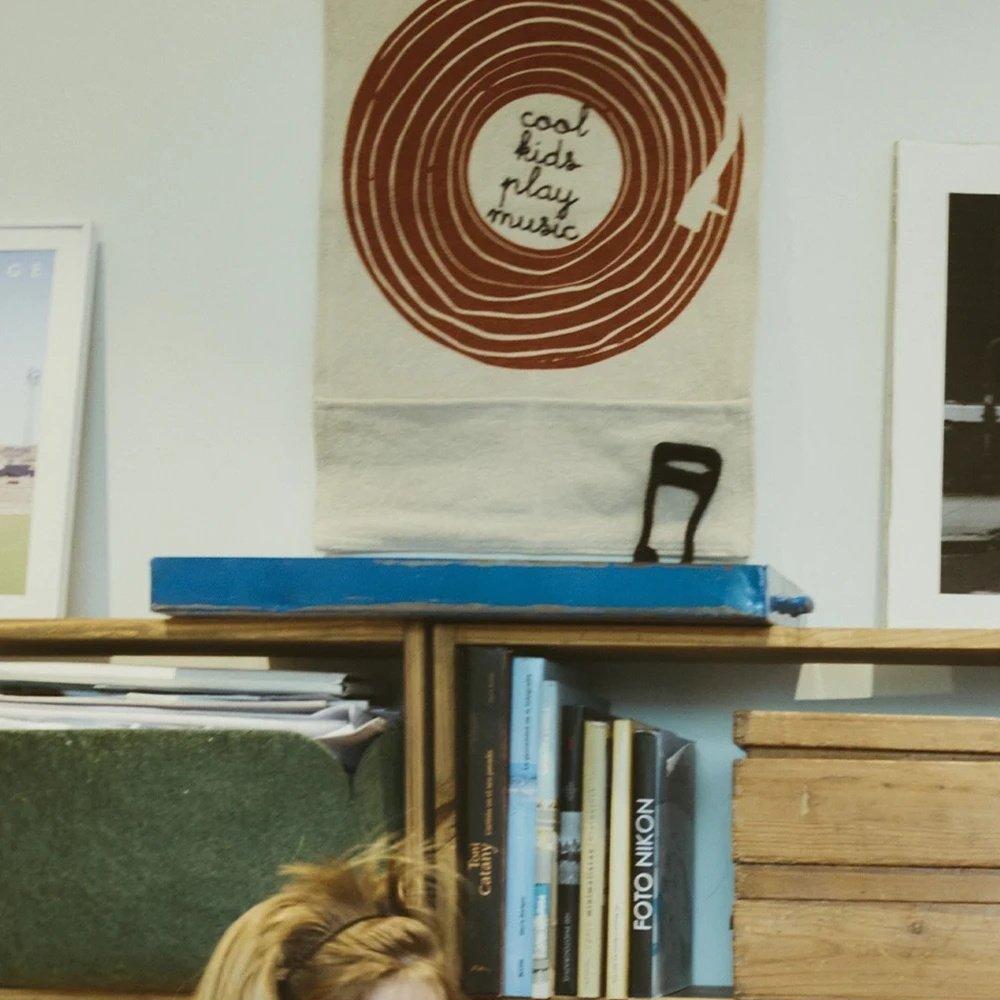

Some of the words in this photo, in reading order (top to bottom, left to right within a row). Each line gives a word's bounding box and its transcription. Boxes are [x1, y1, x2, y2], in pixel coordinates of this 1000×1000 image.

[520, 102, 589, 137] cool
[514, 130, 583, 171] kids
[499, 166, 579, 220] play
[487, 208, 579, 240] music
[466, 841, 481, 870] Toni
[636, 799, 655, 867] NIKON
[478, 841, 499, 896] Catany
[633, 872, 654, 931] FOTO
